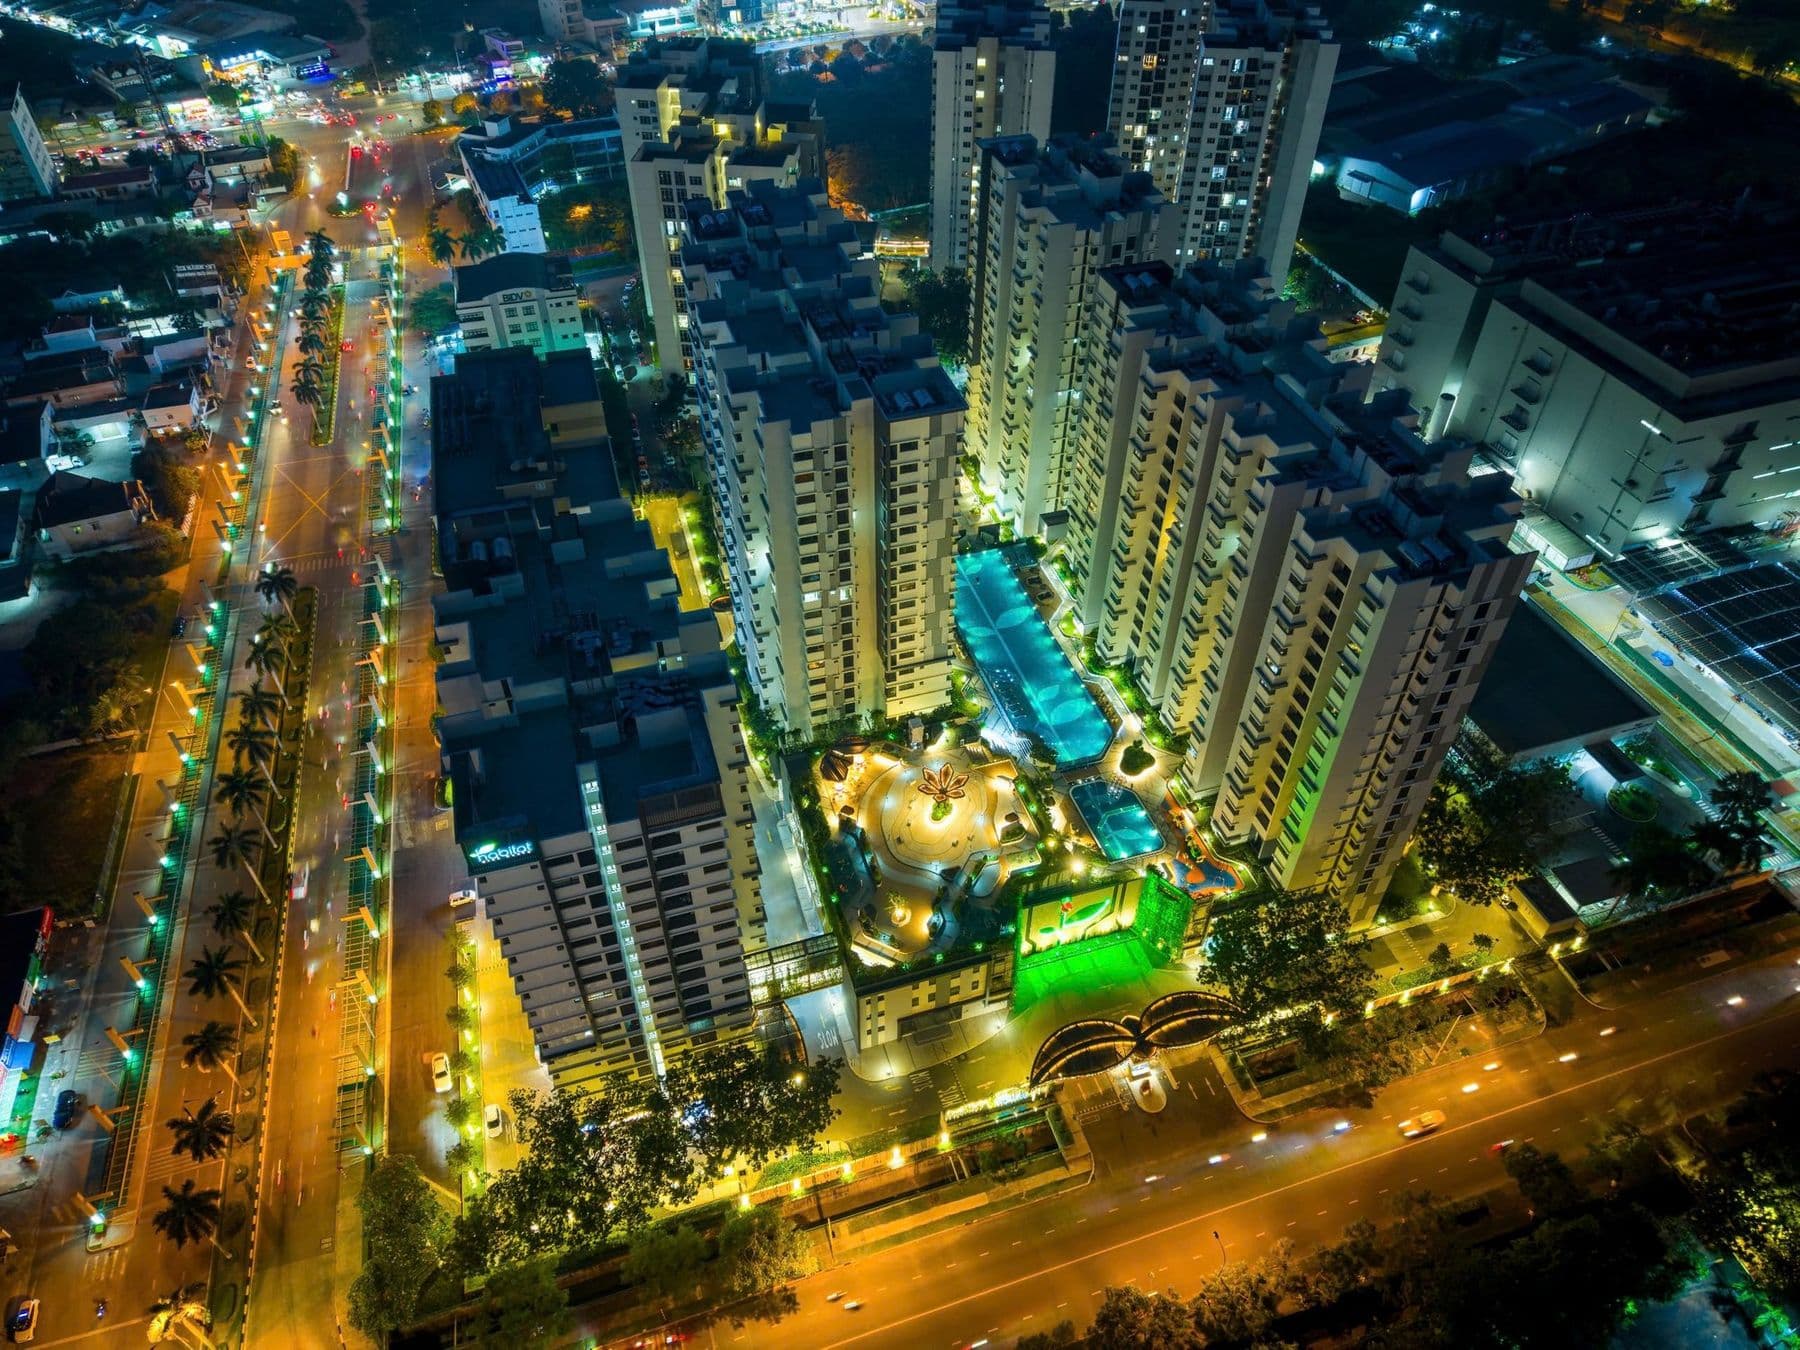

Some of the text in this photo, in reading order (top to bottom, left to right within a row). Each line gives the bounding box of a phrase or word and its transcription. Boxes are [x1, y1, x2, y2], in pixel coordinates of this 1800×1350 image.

[502, 292, 524, 302] BIDV
[475, 841, 534, 862] habitat
[817, 1029, 839, 1050] SLOW
